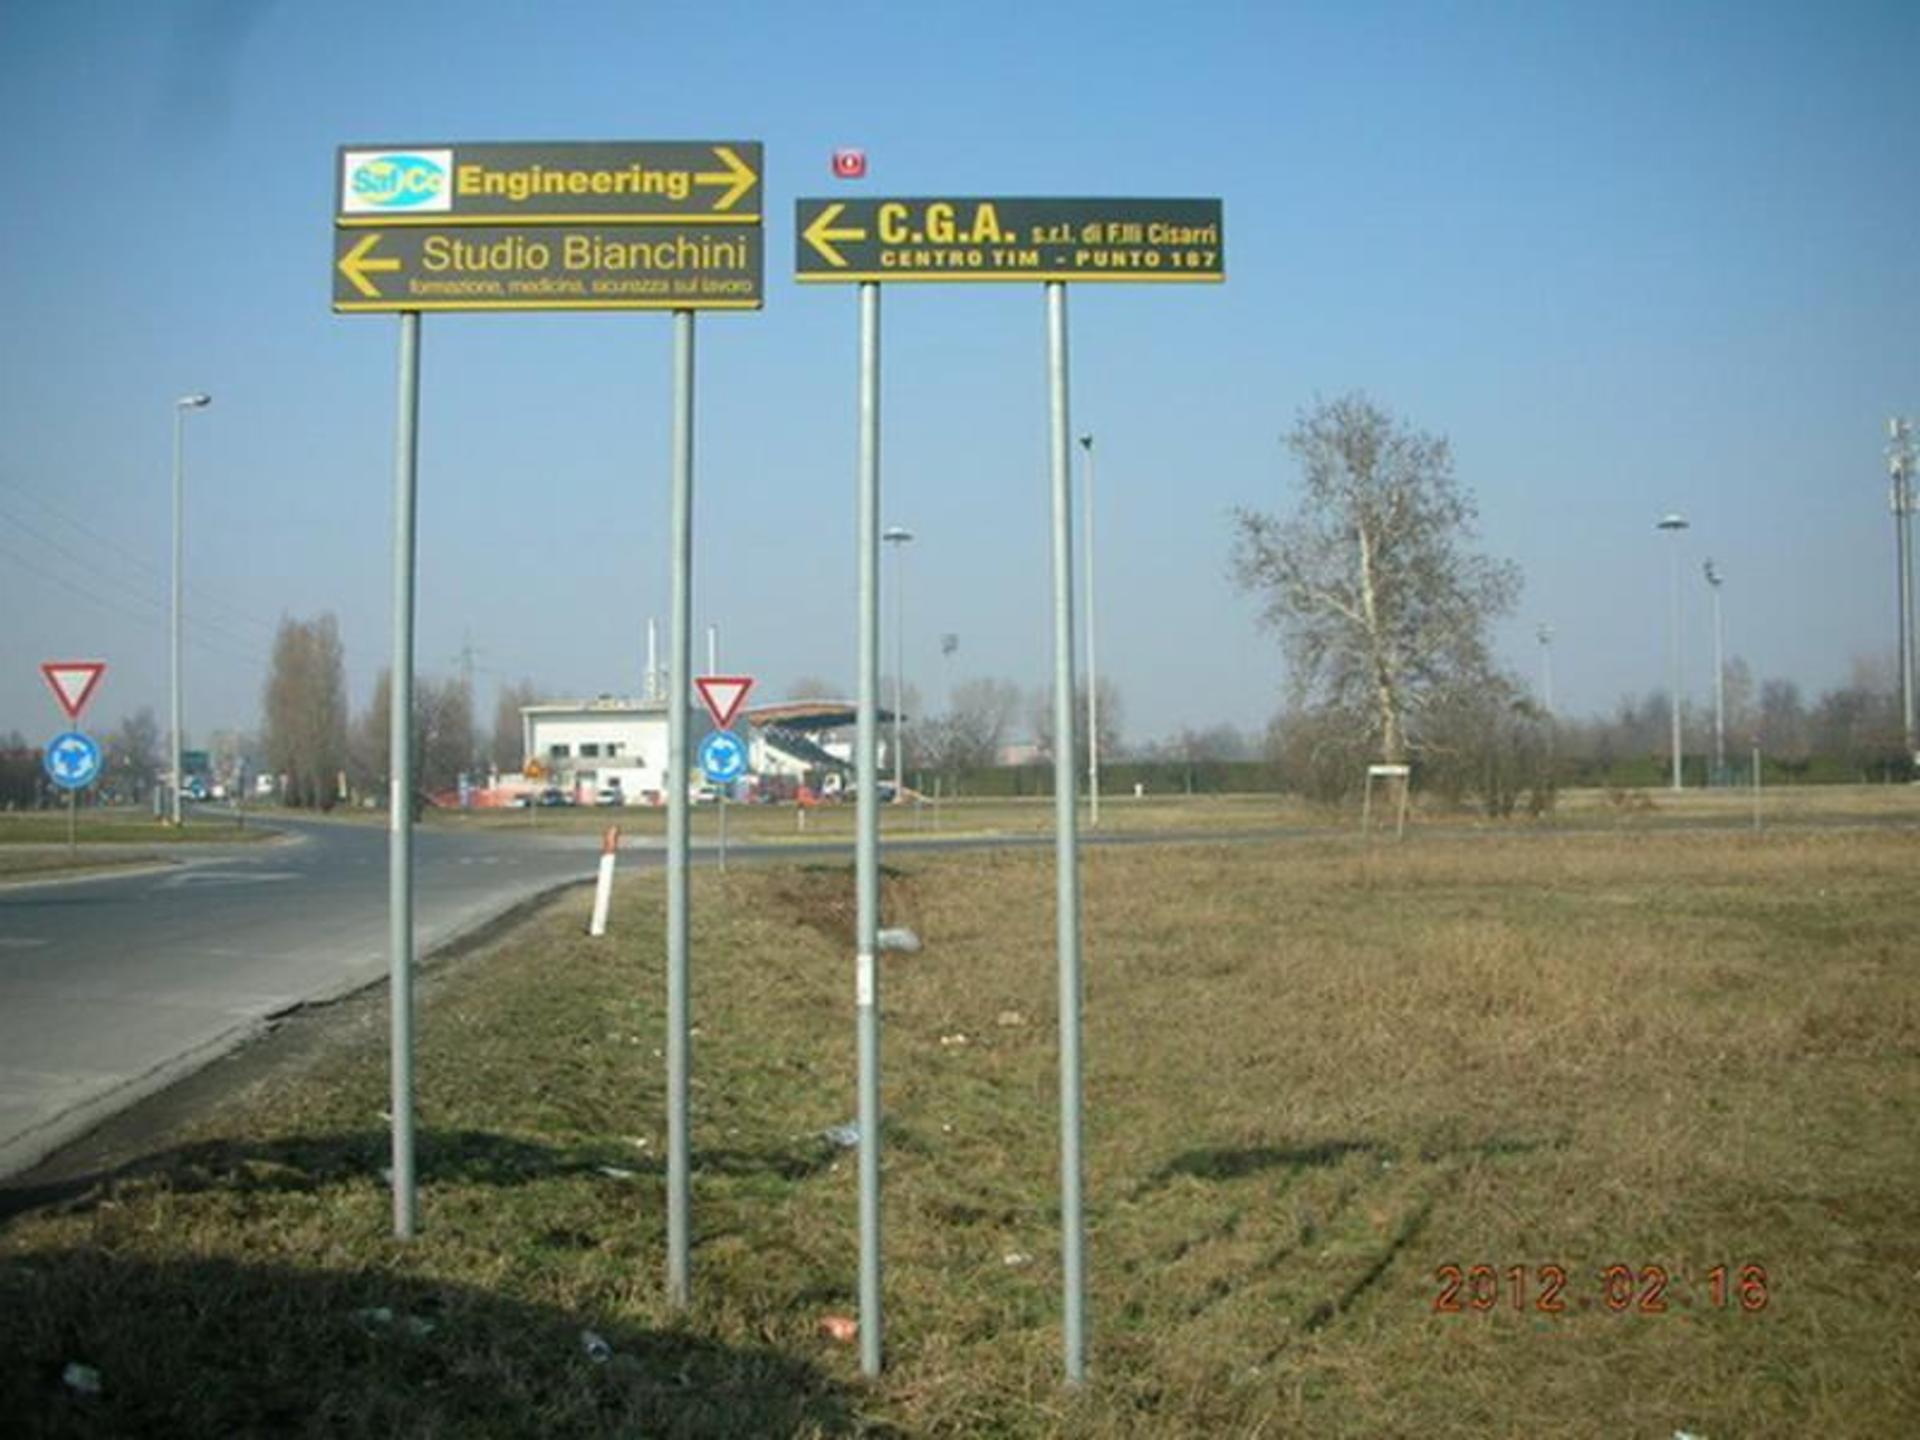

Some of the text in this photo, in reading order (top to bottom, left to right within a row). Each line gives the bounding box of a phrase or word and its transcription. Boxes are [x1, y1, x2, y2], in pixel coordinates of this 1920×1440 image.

[456, 164, 691, 200] Engineering
[879, 202, 1016, 244] C.G.A.
[1081, 222, 1102, 244] di
[421, 234, 748, 272] Studio Bianchini
[880, 249, 983, 267] CENTRO
[991, 249, 1039, 267] TIM
[1075, 249, 1161, 267] PUNTO
